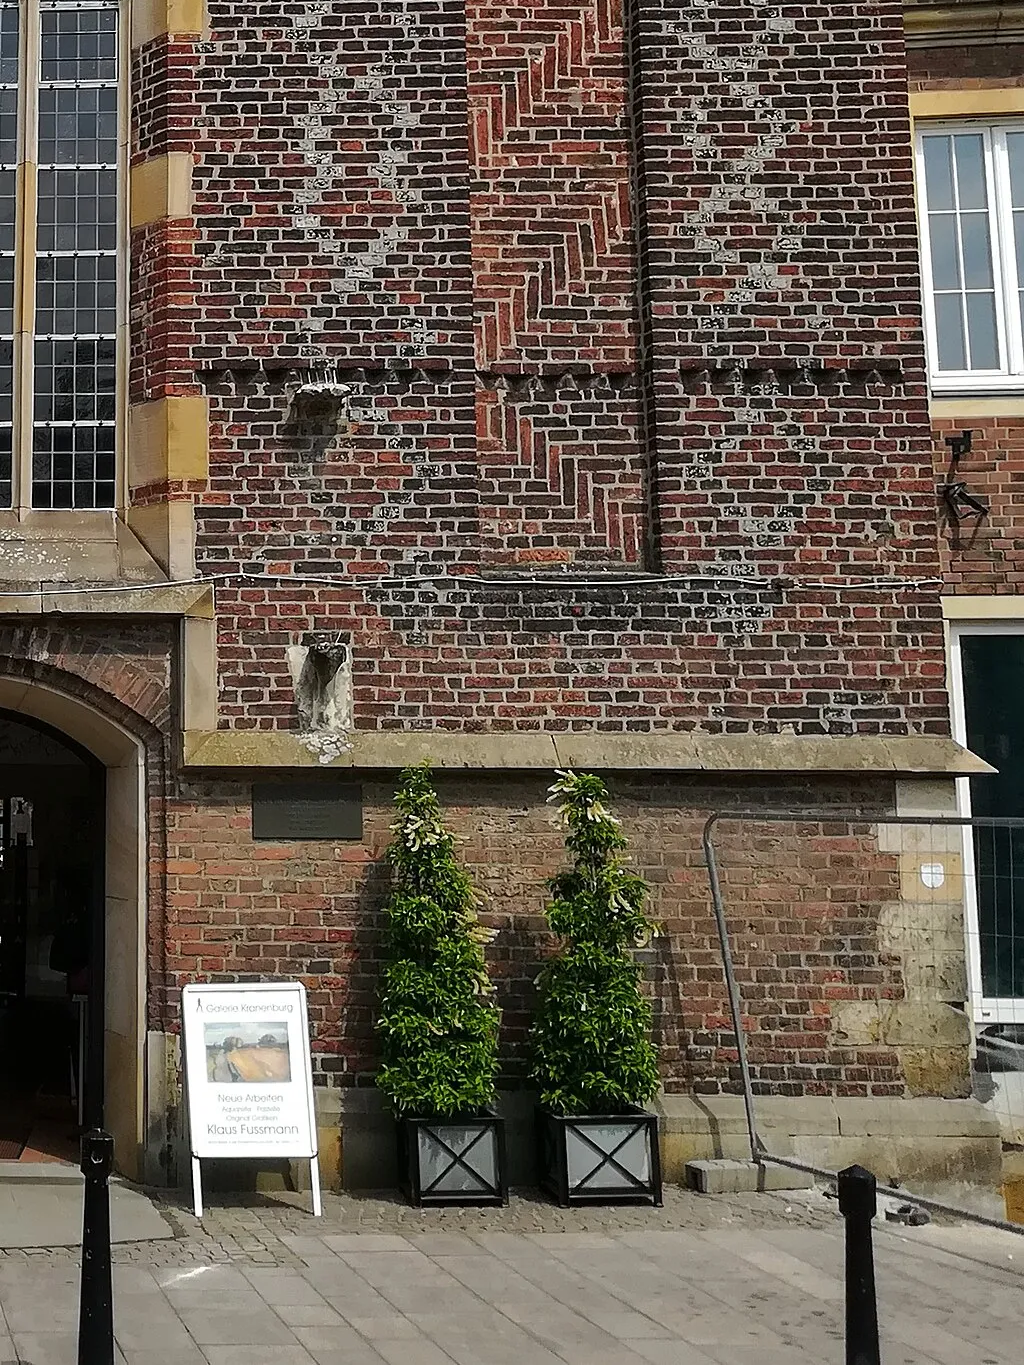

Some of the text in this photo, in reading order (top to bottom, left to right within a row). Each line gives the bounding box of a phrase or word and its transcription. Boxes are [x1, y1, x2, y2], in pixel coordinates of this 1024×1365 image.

[206, 1003, 294, 1013] Galerie Kranenburg
[217, 1094, 284, 1103] Neue Arbeiten
[207, 1124, 299, 1135] Klaus Fussmann
